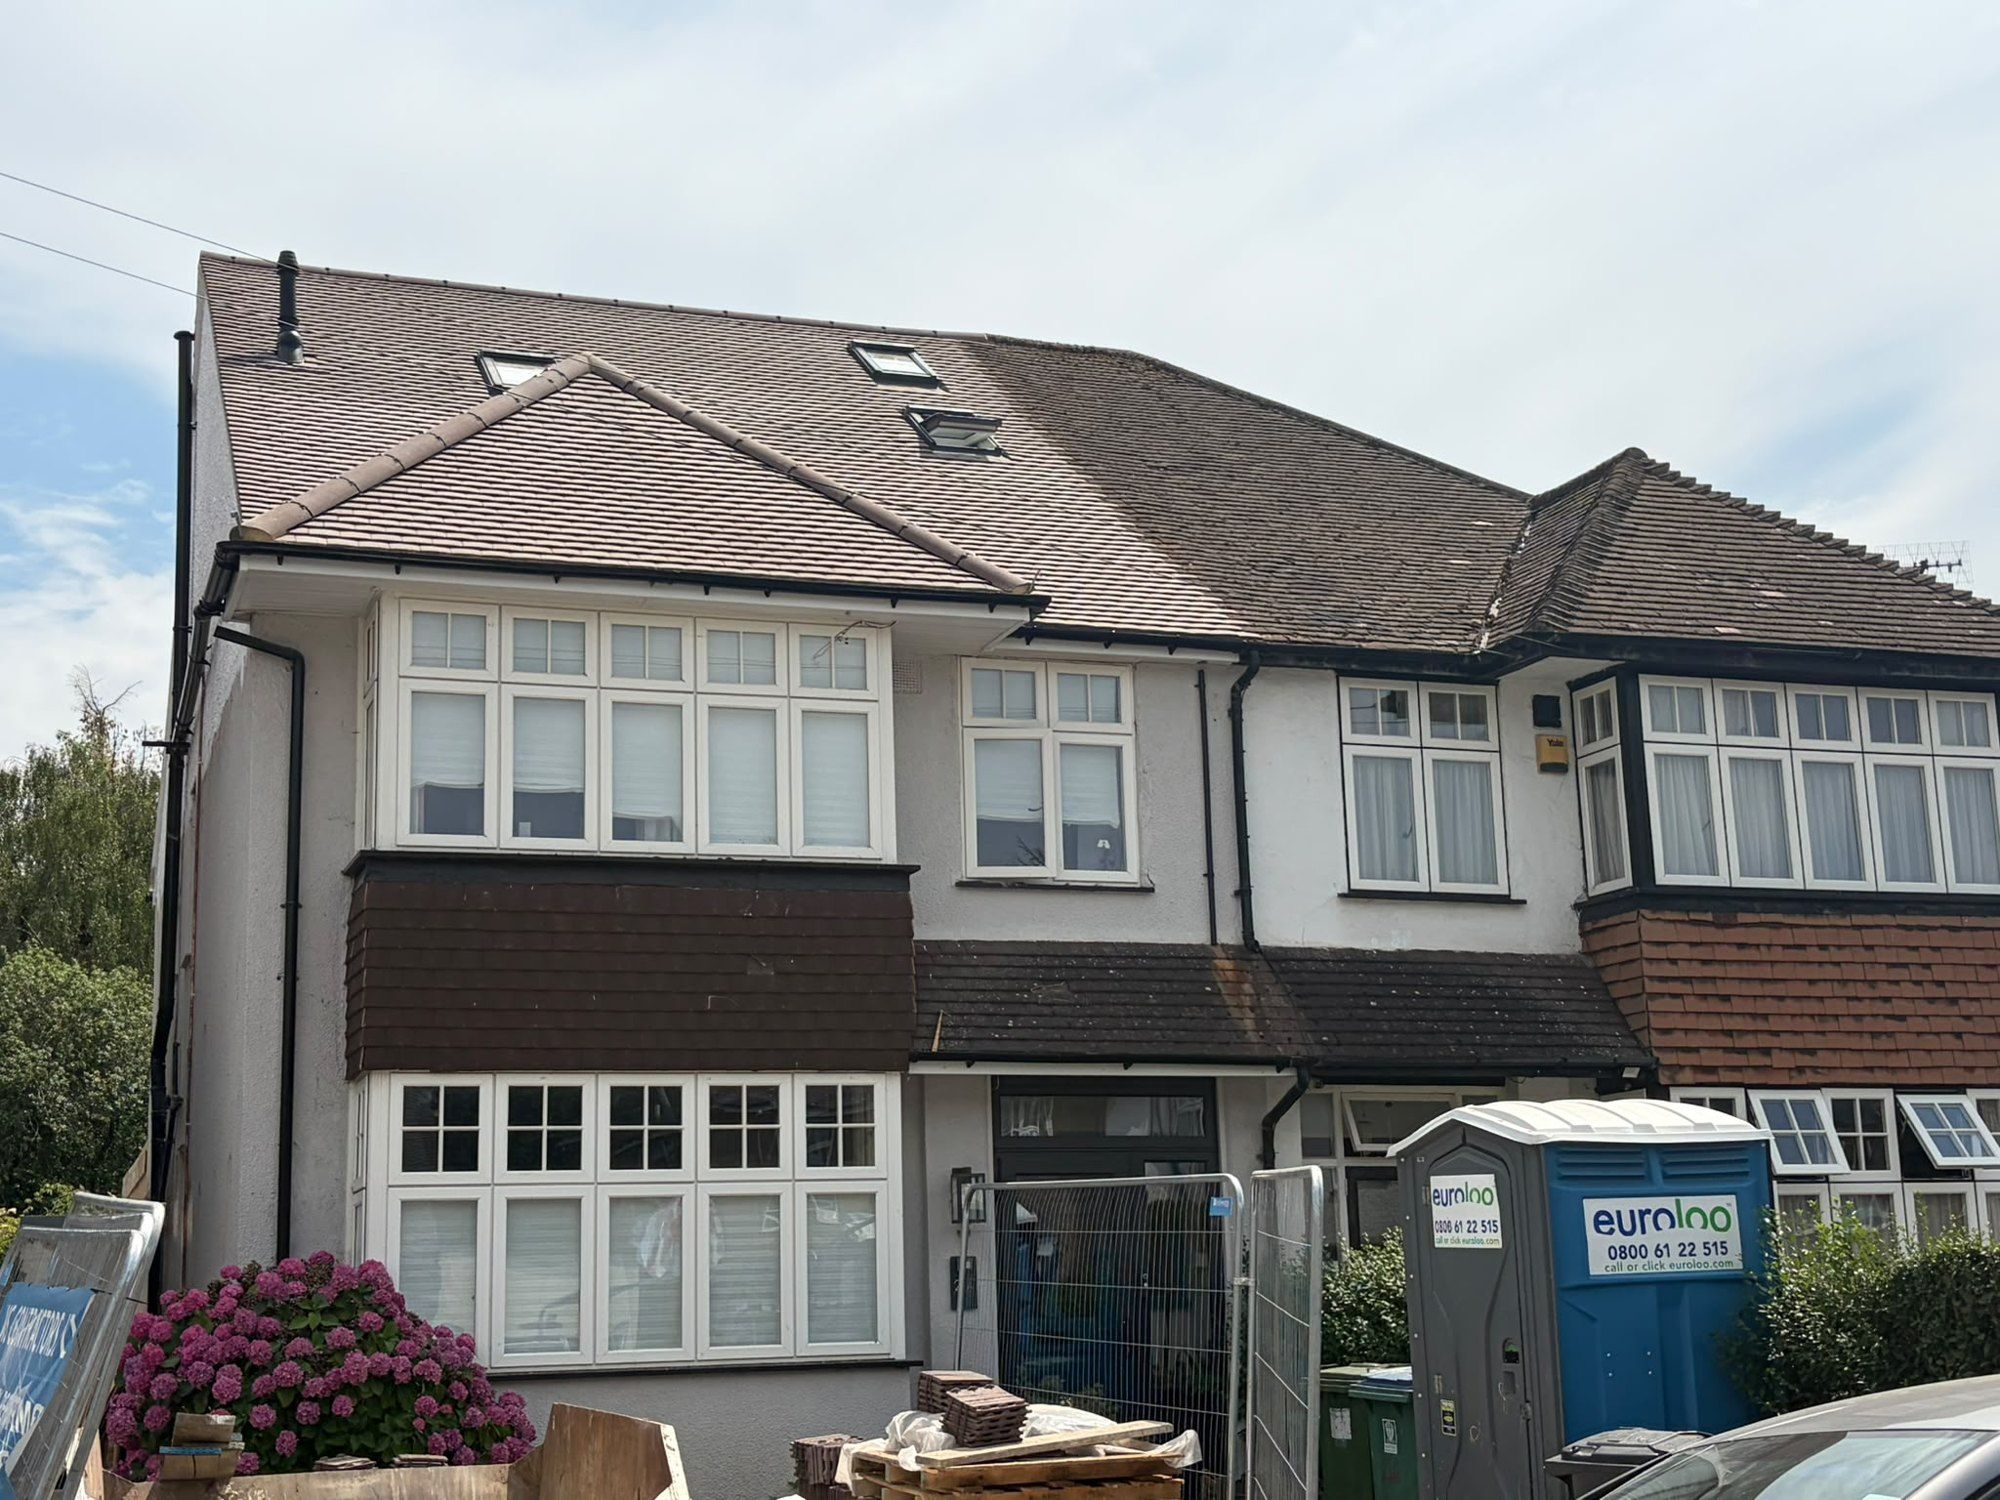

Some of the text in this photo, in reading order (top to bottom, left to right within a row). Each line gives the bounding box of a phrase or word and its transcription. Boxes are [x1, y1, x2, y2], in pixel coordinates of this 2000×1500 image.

[1432, 1181, 1494, 1207] euroloo
[1454, 1220, 1463, 1234] 61
[1467, 1220, 1478, 1234] 22
[1481, 1220, 1499, 1234] 515
[1593, 1199, 1732, 1237] euroloo
[1608, 1241, 1729, 1261] 0800 61 22 515
[1605, 1257, 1734, 1273] call or click euroloo.com
